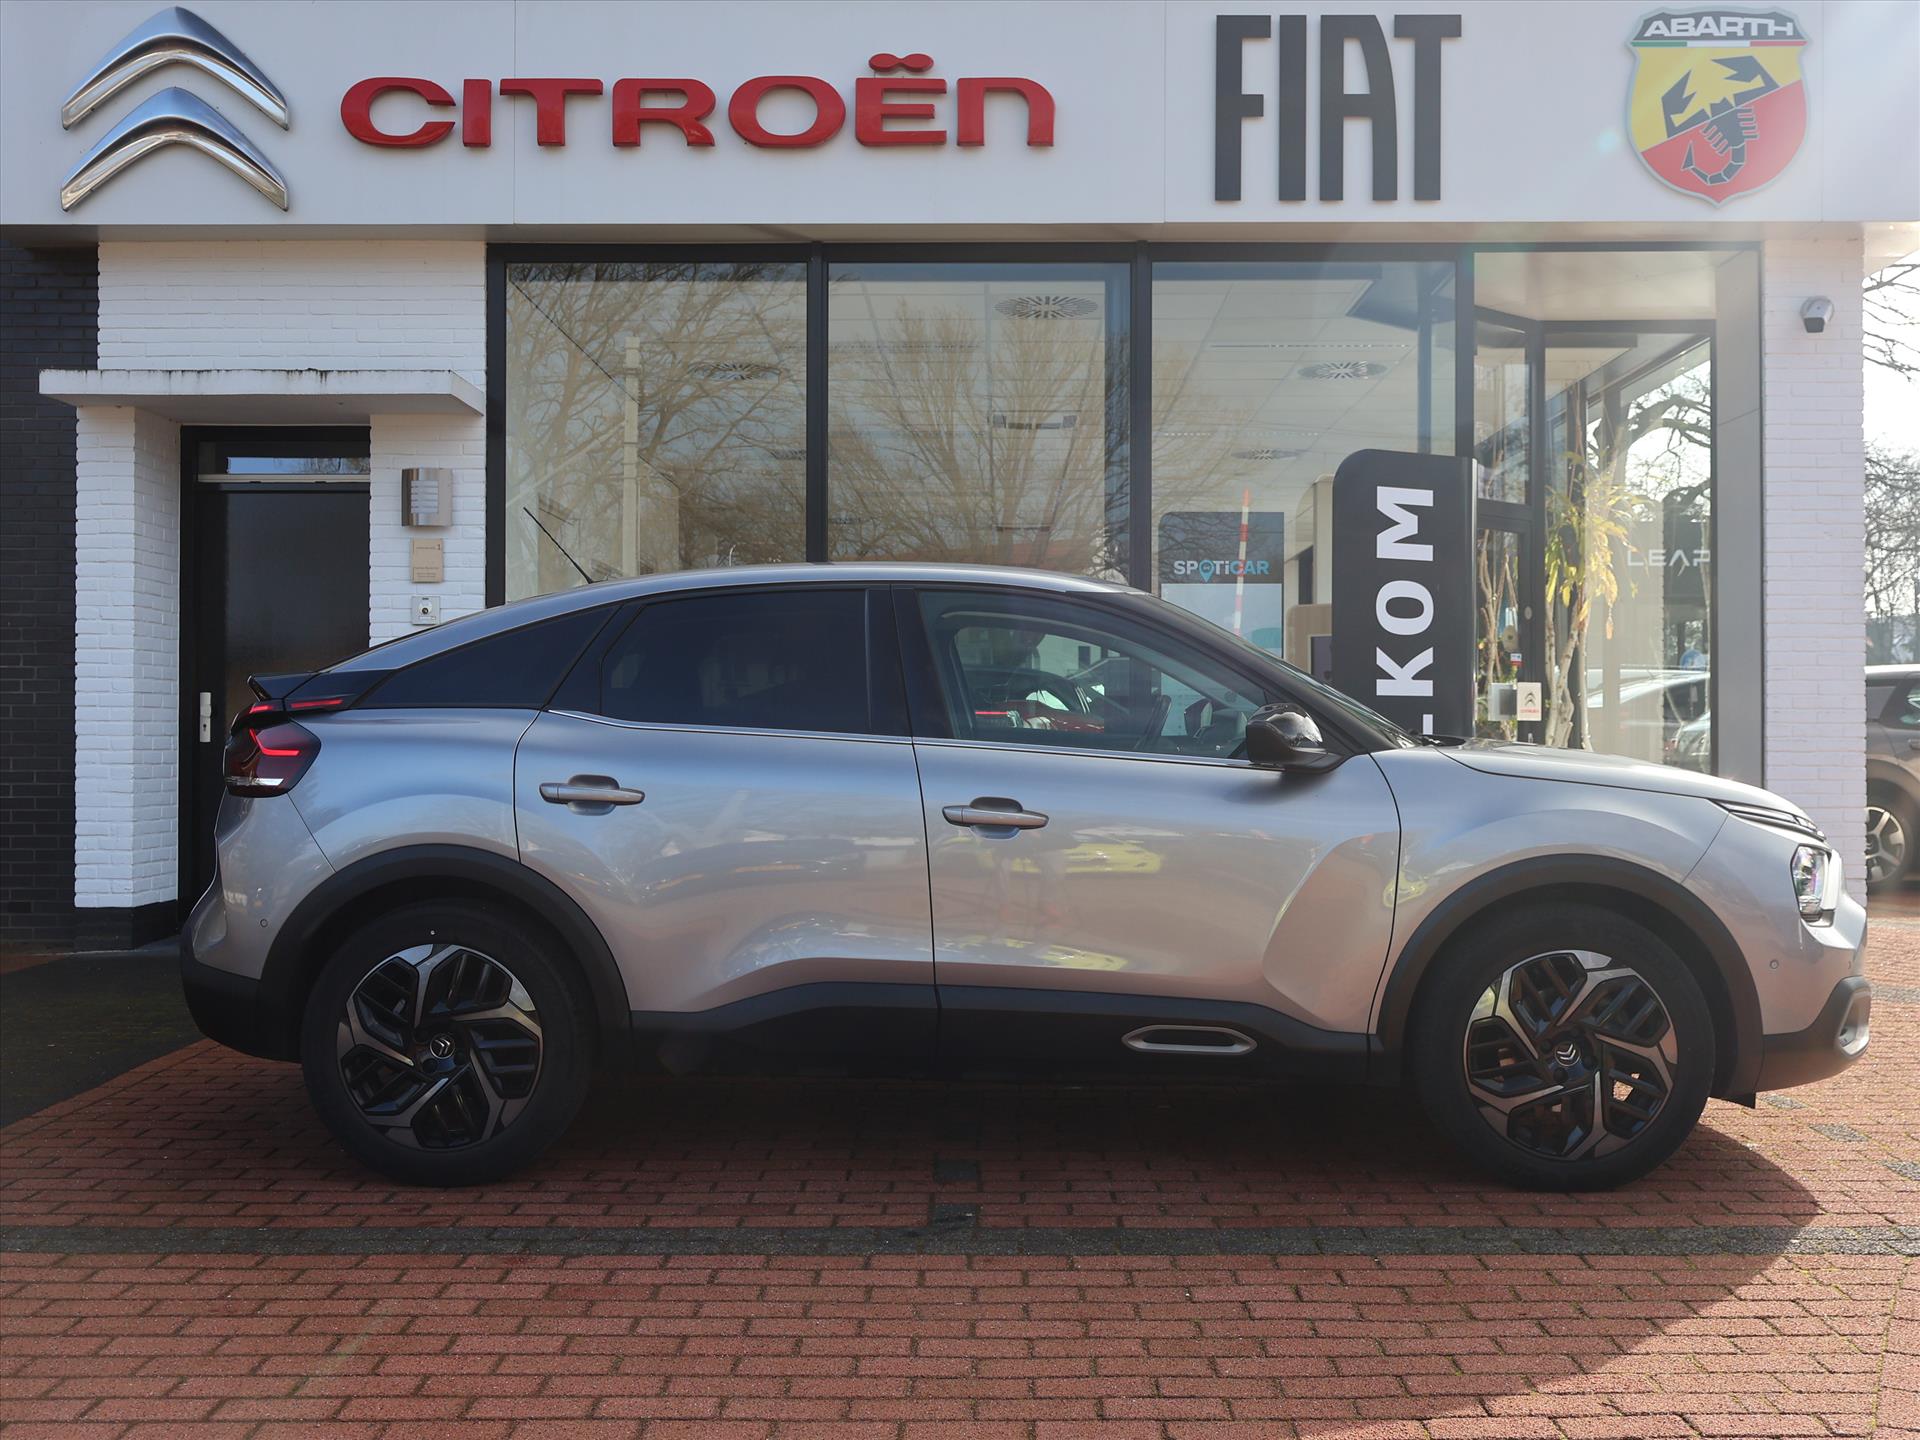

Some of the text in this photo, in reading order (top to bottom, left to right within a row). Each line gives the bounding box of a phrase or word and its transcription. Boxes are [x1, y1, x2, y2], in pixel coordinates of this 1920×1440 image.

[1644, 16, 1793, 37] ABARTH
[340, 53, 1055, 148] CITROËN
[1215, 14, 1462, 201] FIAT
[1173, 560, 1270, 582] SPOTiCAR
